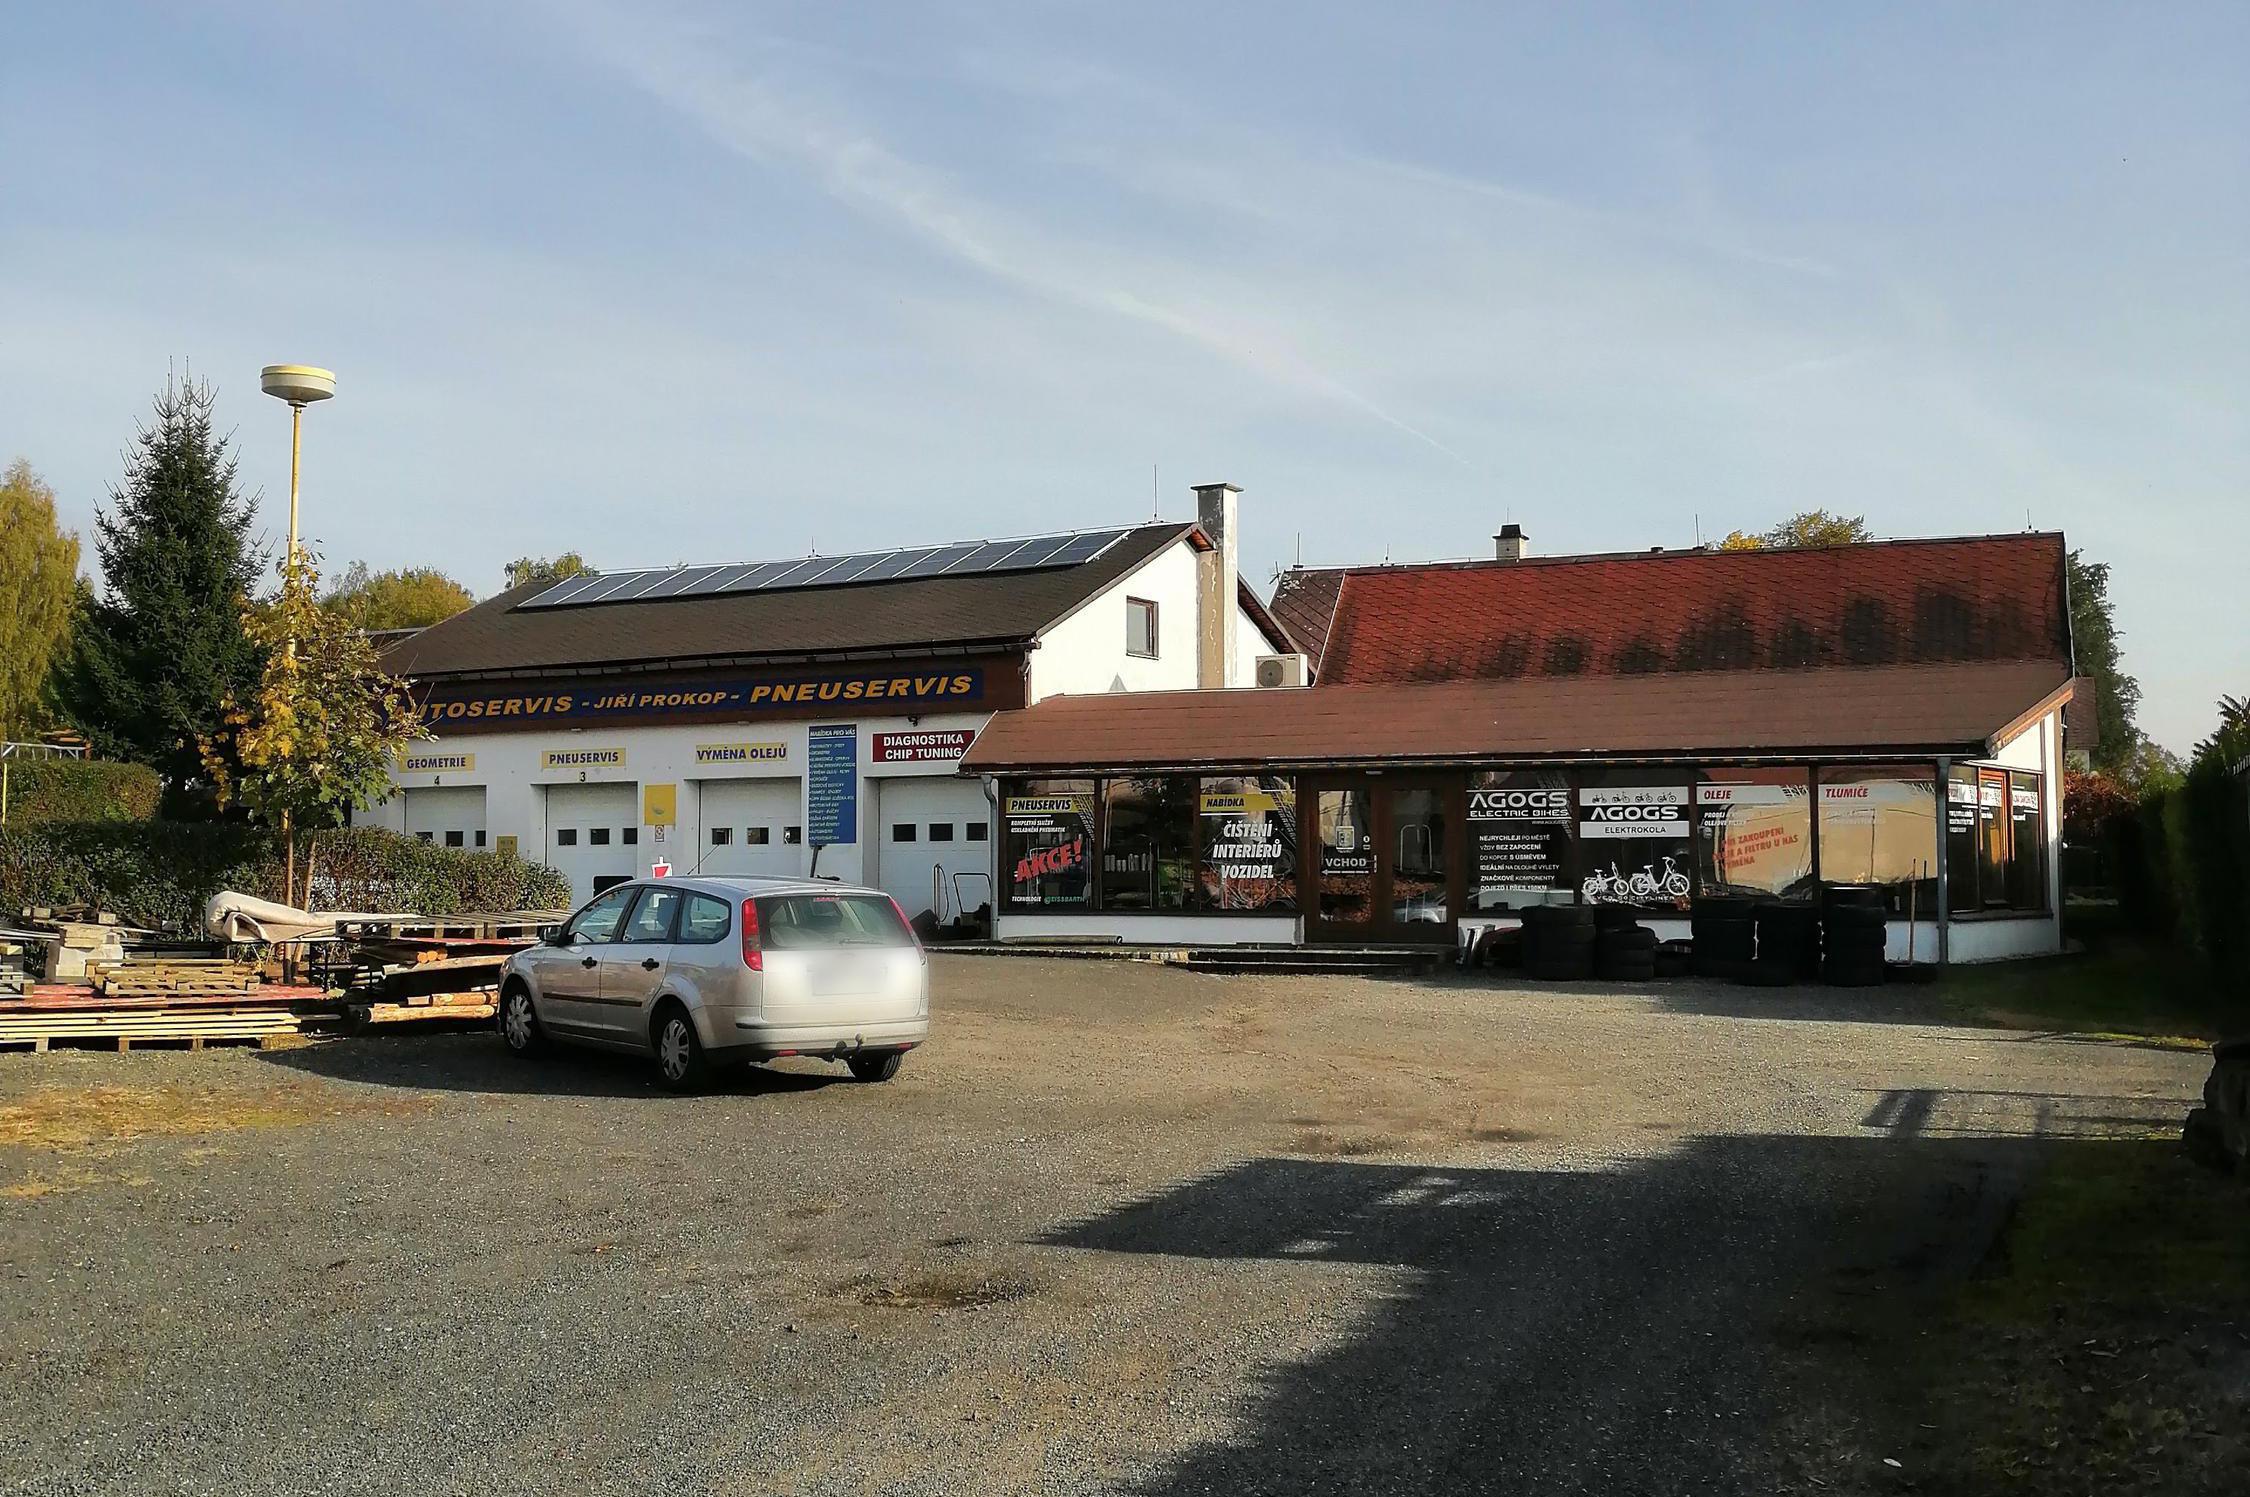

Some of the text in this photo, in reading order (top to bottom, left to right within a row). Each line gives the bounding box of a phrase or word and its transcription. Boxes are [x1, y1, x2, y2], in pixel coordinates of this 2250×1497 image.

[594, 693, 635, 710] JIŘÍ
[639, 691, 727, 708] PROKOP
[751, 675, 973, 703] PNEUSERVIS
[883, 733, 964, 747] DIAGNOSTIKA
[549, 751, 618, 764] PNEUSERVIS
[697, 743, 787, 760] VÝMĚNA OLEJŮ
[885, 747, 962, 760] CHIP TUNING
[407, 756, 466, 769] GEOMETRIE
[434, 775, 440, 785] 4
[580, 771, 586, 782] 3
[1704, 790, 1731, 799] OLEJE
[1826, 787, 1868, 799] TLUMIČE
[1011, 799, 1071, 811] PNEUSERVIS
[1206, 796, 1244, 807] NABÍDKA
[1470, 792, 1568, 808] AGOGS
[1470, 809, 1569, 817] ELECTRIC BIKES
[1590, 806, 1679, 821] AGOGS
[1223, 820, 1273, 837] ČIŠTĚNÍ
[1604, 826, 1667, 834] ELEKTROKOLA
[1213, 839, 1282, 858] INTERIÉRŮ
[1015, 839, 1082, 883] AKCE!
[1325, 858, 1367, 867] VCHOD
[1221, 864, 1274, 879] VOZIDEL
